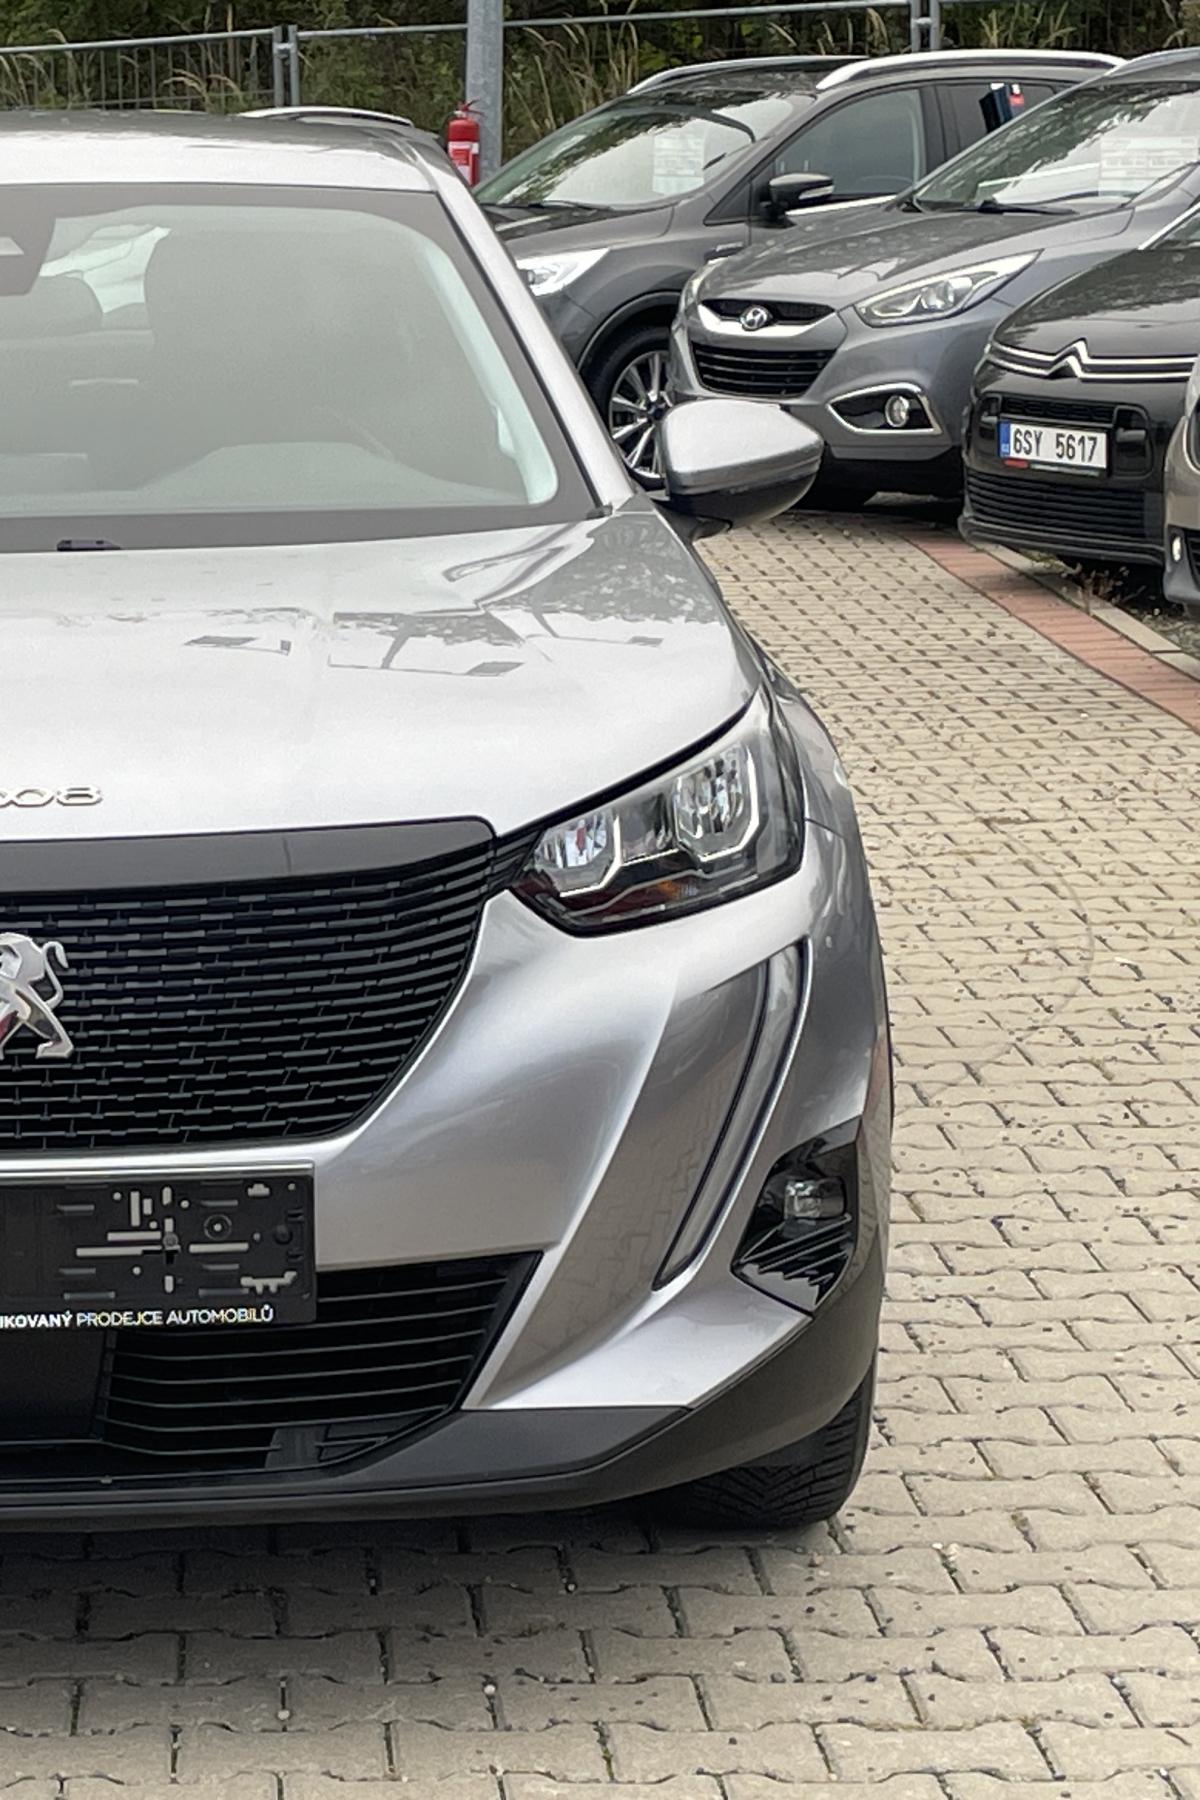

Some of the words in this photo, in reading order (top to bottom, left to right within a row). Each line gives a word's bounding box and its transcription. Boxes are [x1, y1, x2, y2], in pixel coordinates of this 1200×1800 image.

[1013, 428, 1043, 456] 6SY
[1056, 433, 1098, 462] 5617
[76, 1311, 163, 1327] PRODEJCE
[166, 1304, 274, 1325] AUTOMOBILŮ
